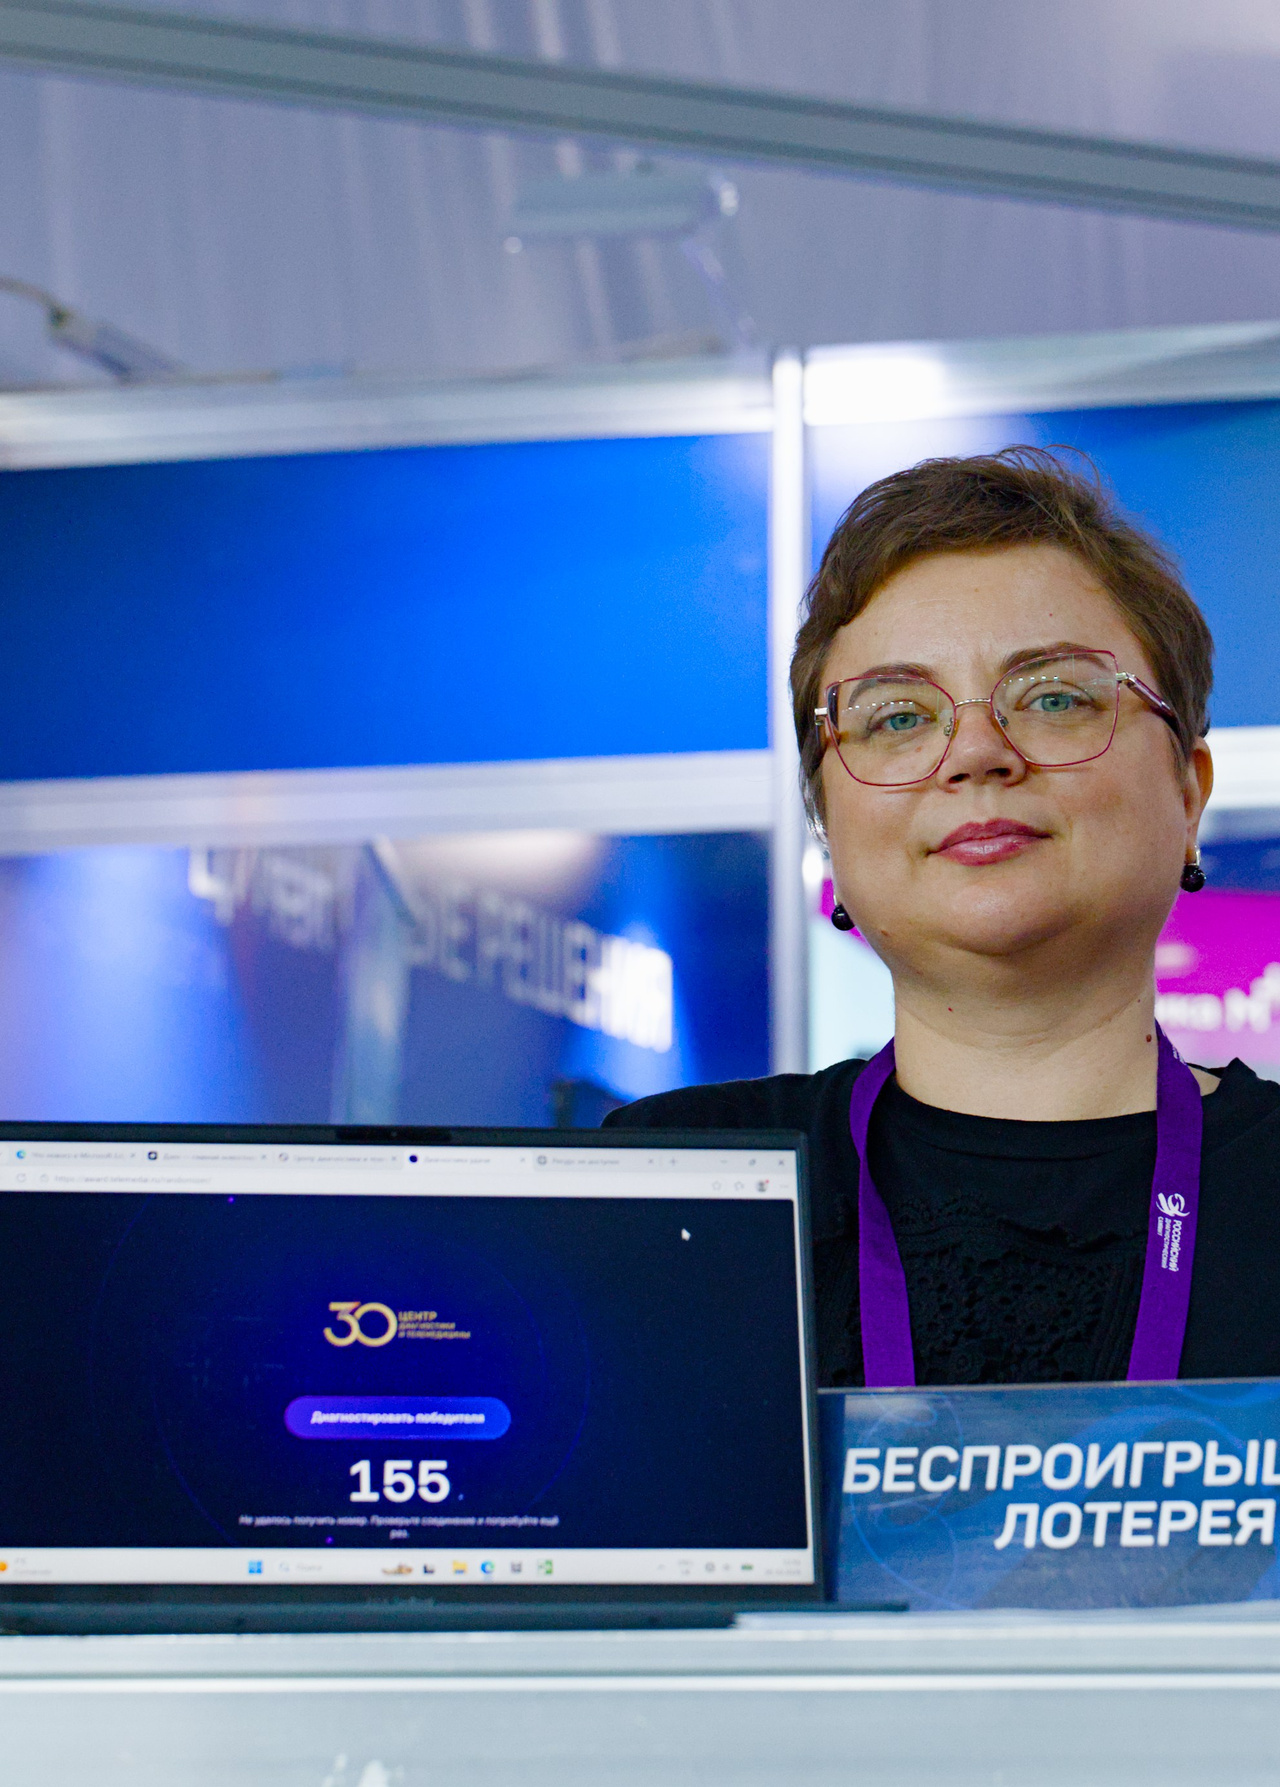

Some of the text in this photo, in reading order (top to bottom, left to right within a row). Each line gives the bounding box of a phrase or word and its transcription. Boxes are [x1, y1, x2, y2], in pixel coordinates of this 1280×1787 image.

[1168, 1219, 1182, 1272] РОССИЙСКИЙ
[323, 1301, 398, 1347] 30
[398, 1311, 438, 1321] ЦЕНТР
[416, 1411, 486, 1426] победителя
[350, 1459, 450, 1503] 155
[994, 1499, 1278, 1551] ЛОТЕРЕЯ
